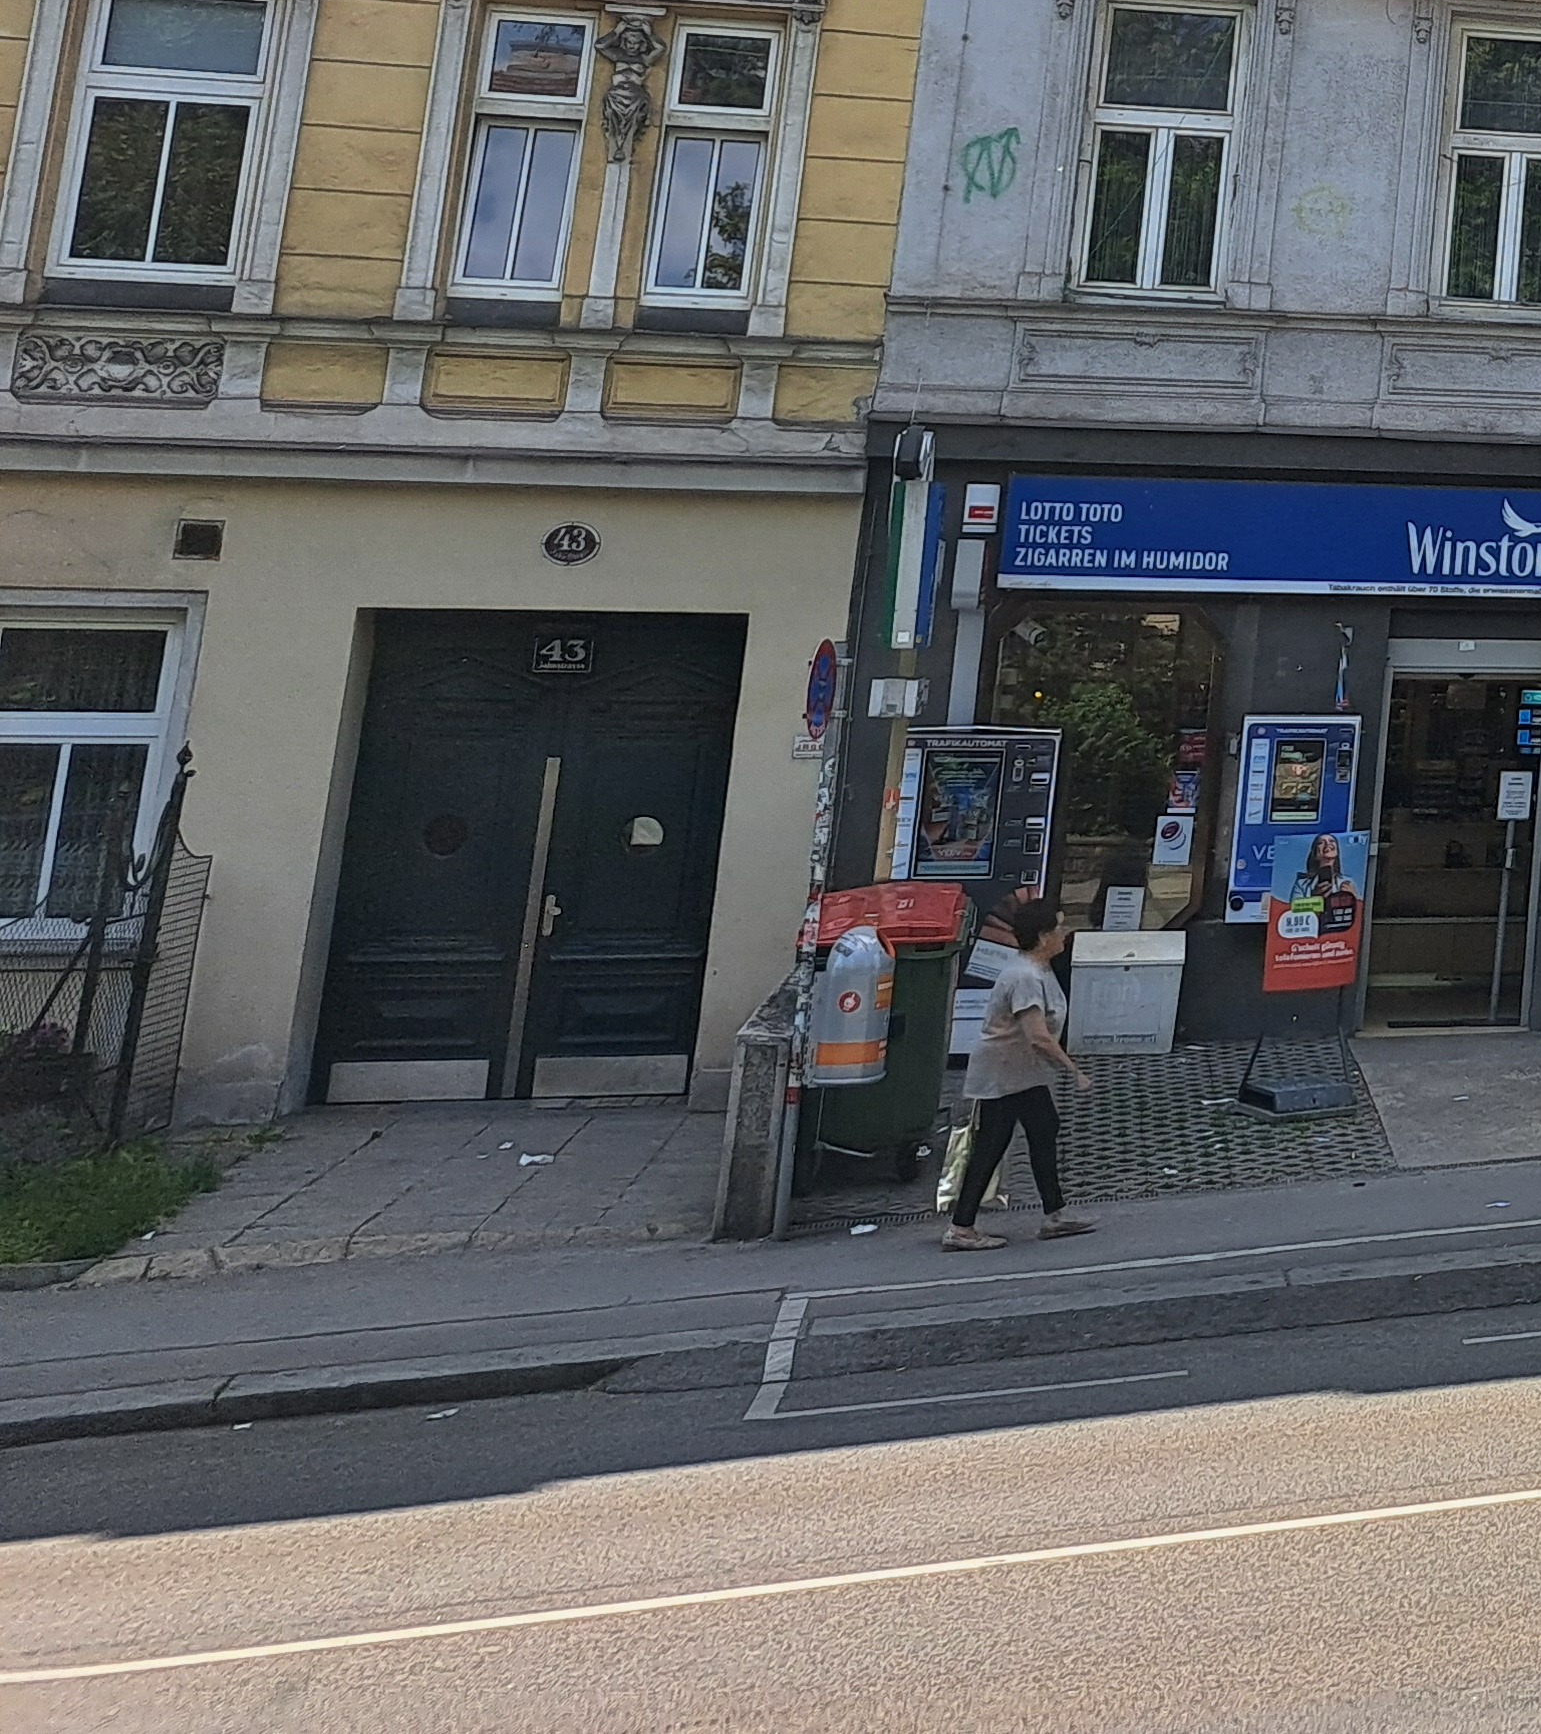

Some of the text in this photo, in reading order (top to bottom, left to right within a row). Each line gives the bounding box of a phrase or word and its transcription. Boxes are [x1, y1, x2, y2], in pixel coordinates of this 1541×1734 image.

[1020, 501, 1123, 522] LOTTO TOTO
[553, 528, 587, 551] 43
[1017, 524, 1093, 544] TICKETS
[1014, 547, 1229, 571] ZIGARREN IM HUMIDOR
[1428, 586, 1439, 594] 70
[539, 639, 587, 662] 43
